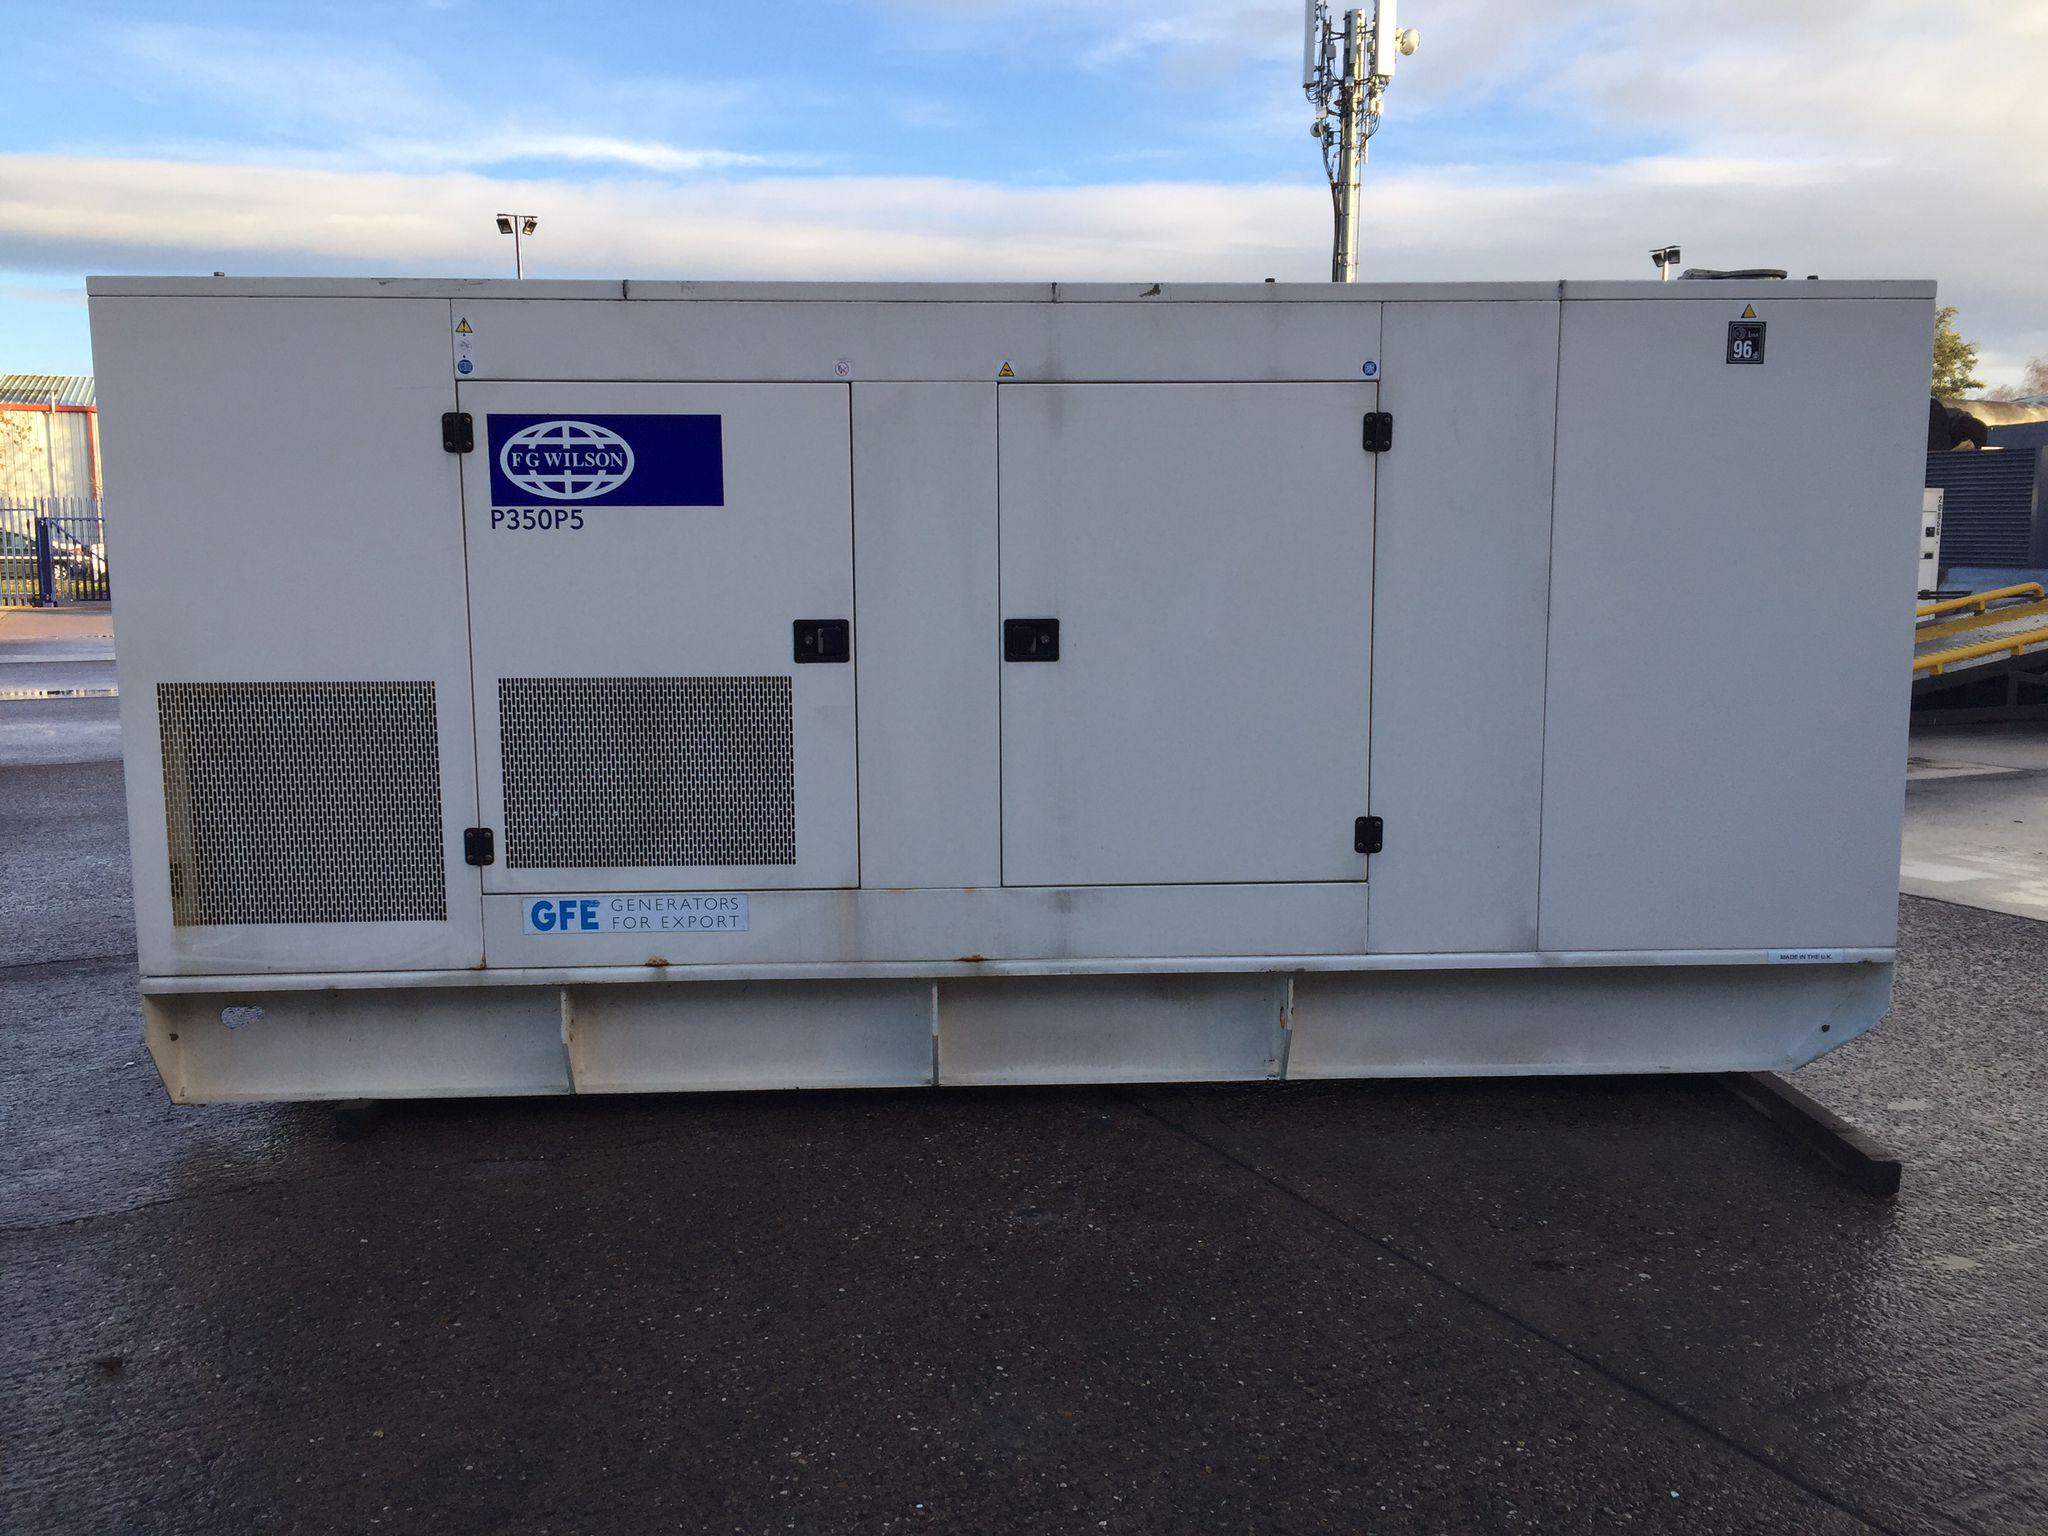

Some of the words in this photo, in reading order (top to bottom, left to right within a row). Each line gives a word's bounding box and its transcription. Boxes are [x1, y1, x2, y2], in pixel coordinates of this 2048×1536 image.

[1733, 340, 1752, 358] 96
[544, 452, 624, 467] WILSON
[491, 508, 584, 530] P350P5
[611, 897, 739, 912] GENERATORS
[531, 900, 600, 932] GFE
[612, 916, 651, 929] FOR
[661, 915, 740, 929] EXPORT
